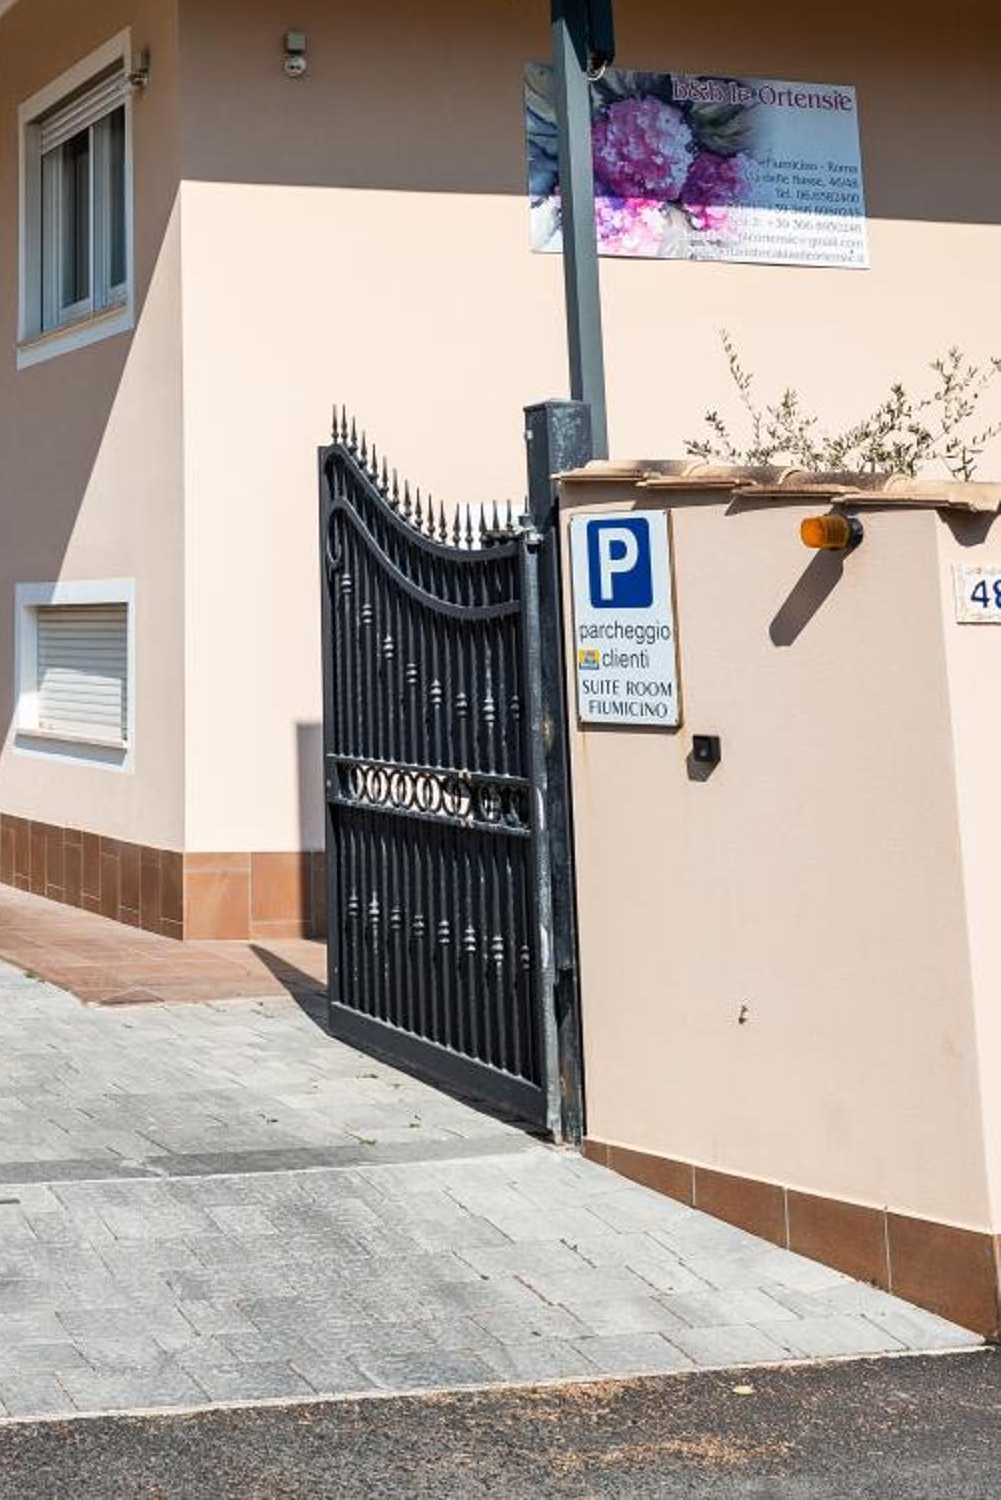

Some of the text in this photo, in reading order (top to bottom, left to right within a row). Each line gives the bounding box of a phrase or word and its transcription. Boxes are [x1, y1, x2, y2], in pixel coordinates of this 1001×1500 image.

[758, 85, 854, 112] Ortensie
[598, 528, 638, 600] P
[579, 620, 671, 645] parcheggio
[602, 649, 650, 668] clienti
[582, 679, 672, 697] SUITE ROOM
[588, 699, 668, 718] FIUMICINO
